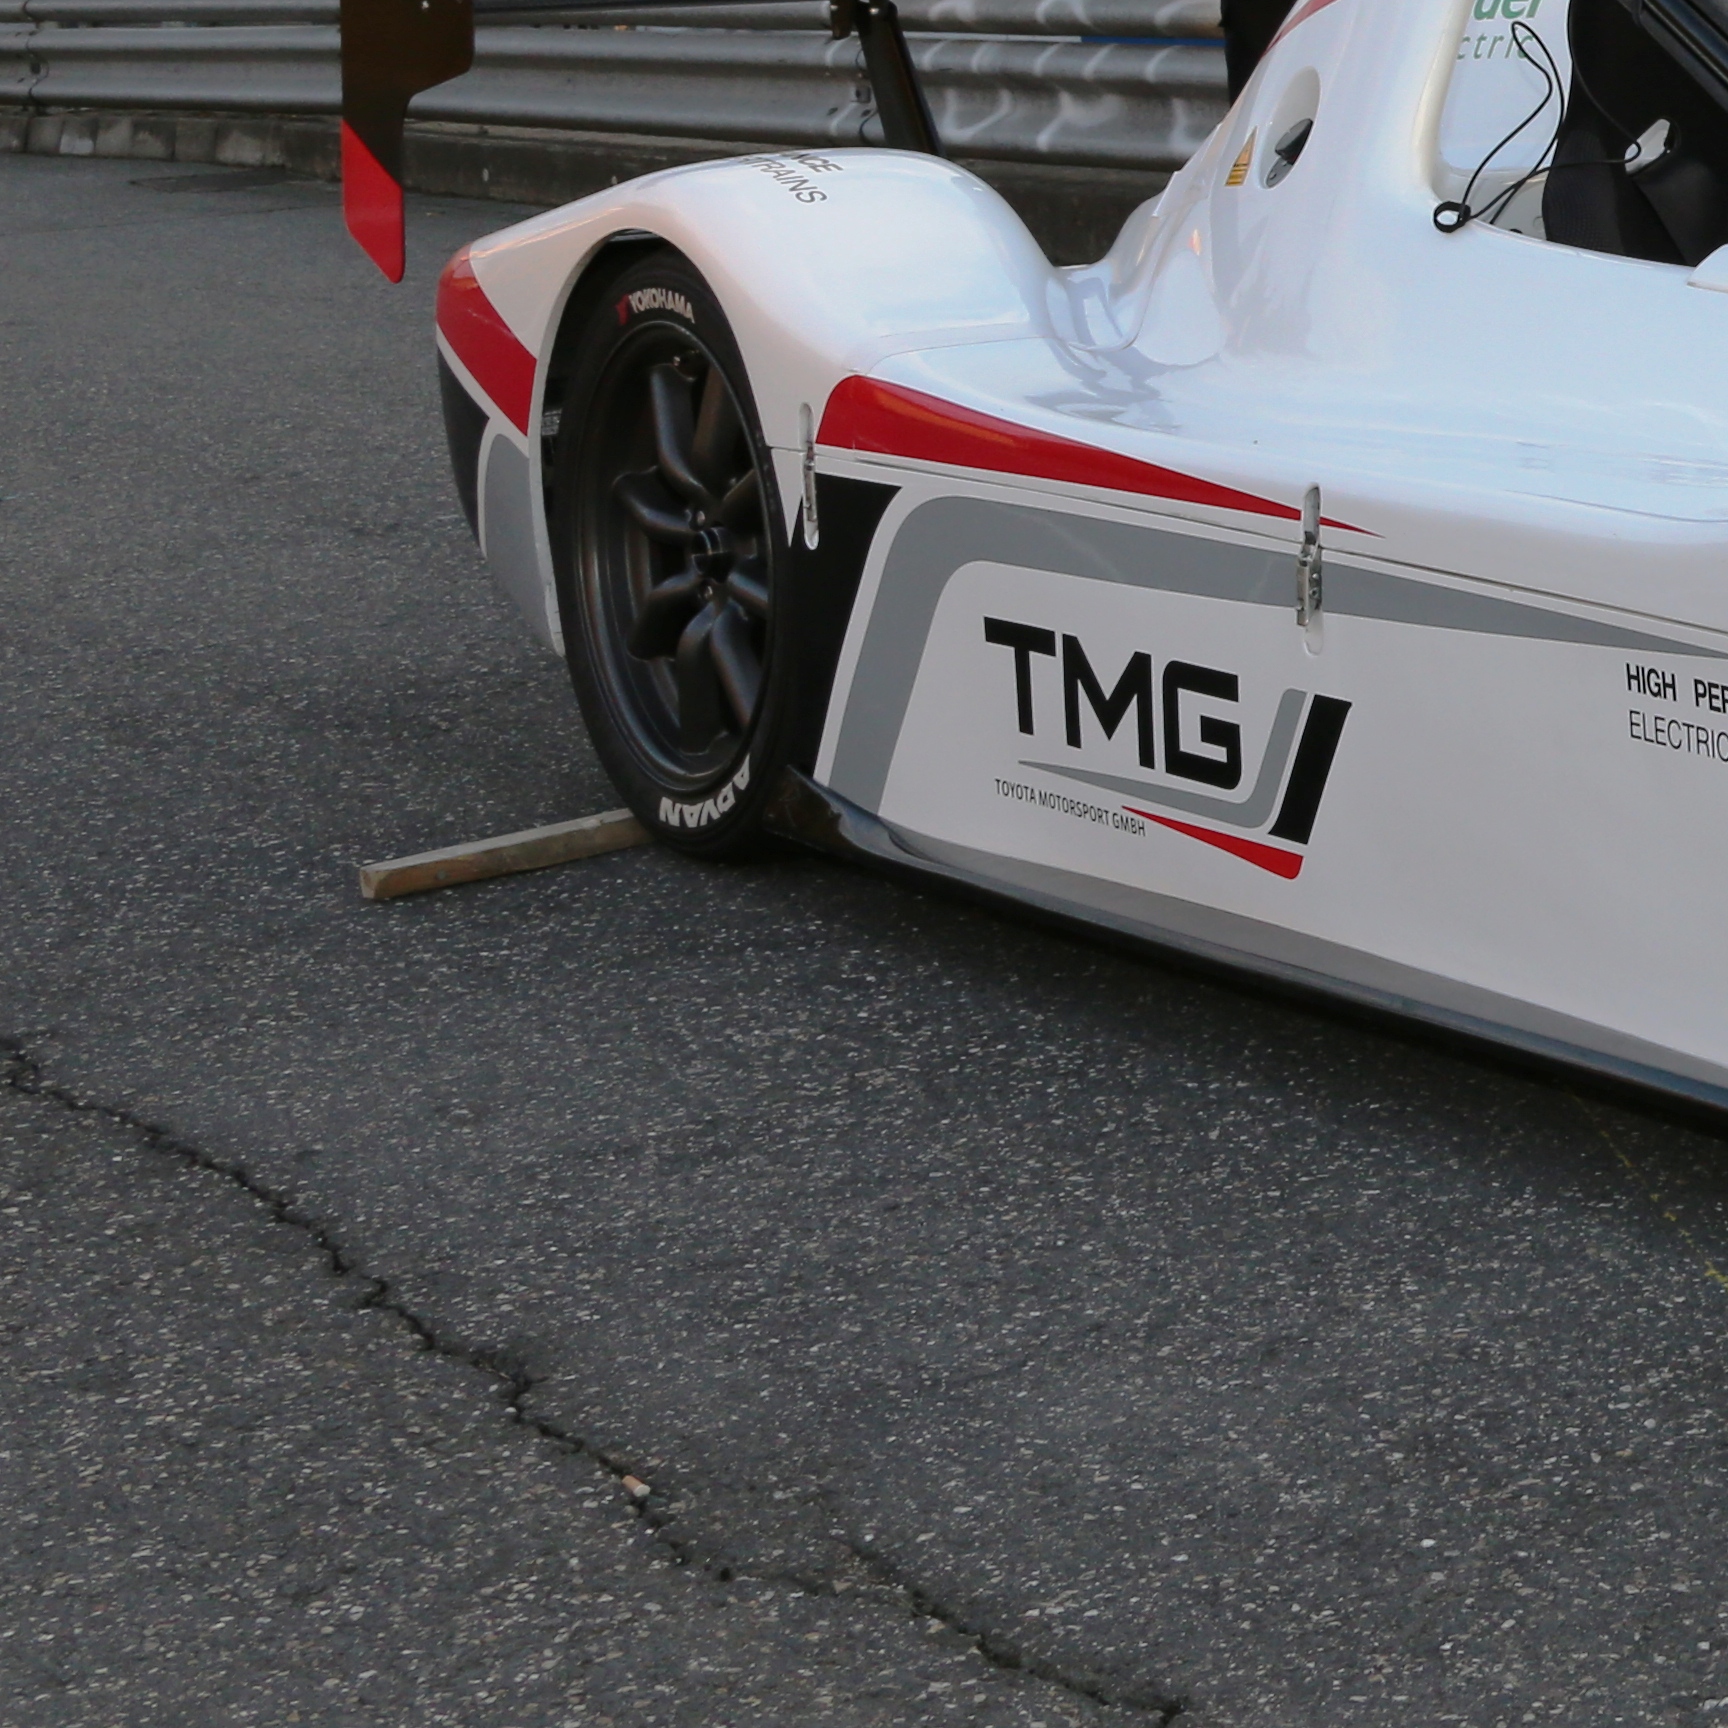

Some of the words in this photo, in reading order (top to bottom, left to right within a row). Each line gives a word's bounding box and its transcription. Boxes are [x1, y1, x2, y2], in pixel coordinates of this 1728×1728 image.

[628, 287, 696, 324] YOKOHAMA
[1624, 662, 1678, 702] HIGH
[659, 753, 751, 829] ADVAN
[994, 777, 1037, 806] TOYOTA
[1038, 789, 1109, 826] MOTORSPORT
[1111, 812, 1147, 838] GMBH
